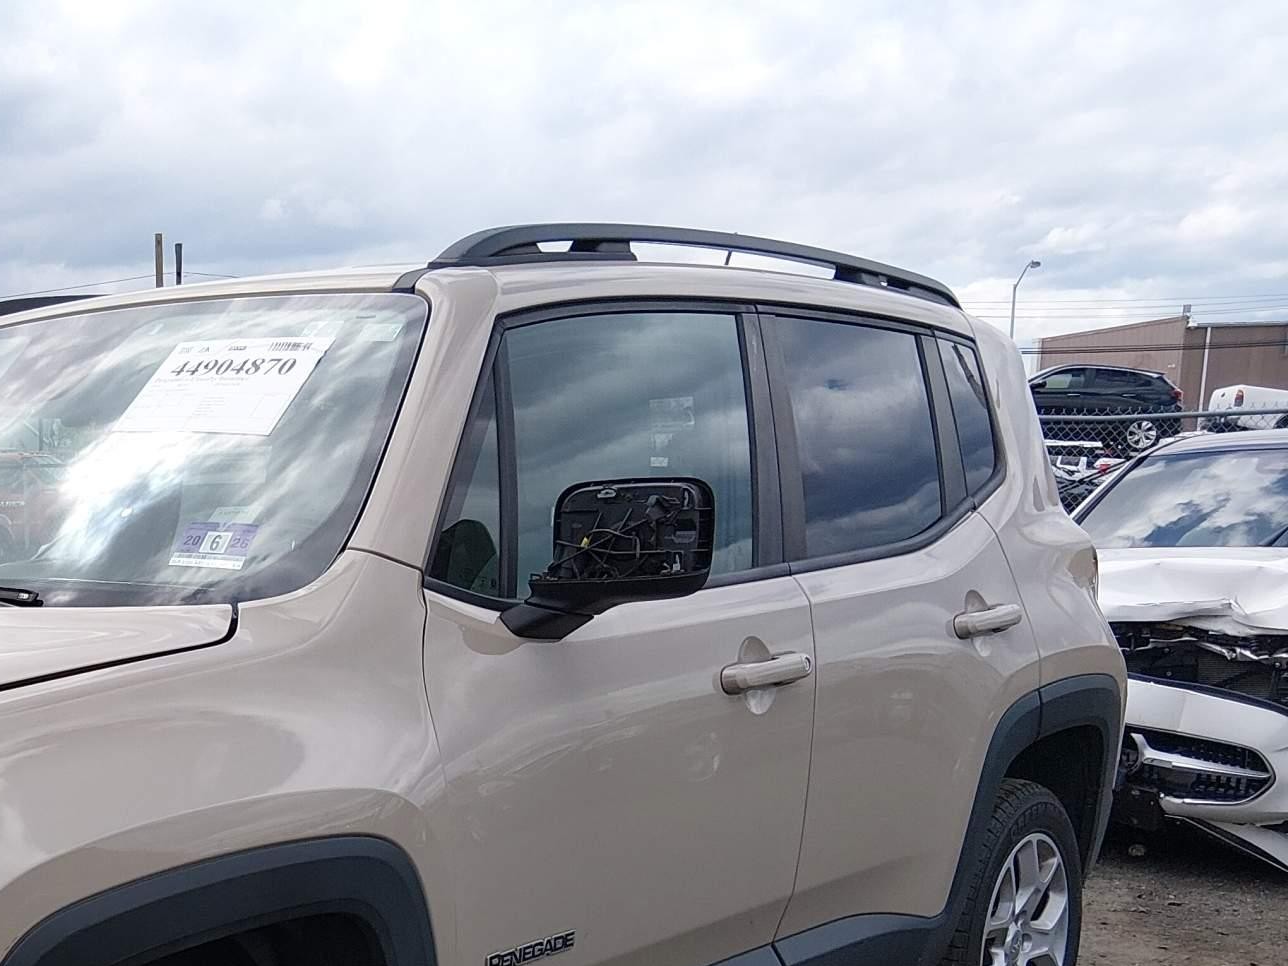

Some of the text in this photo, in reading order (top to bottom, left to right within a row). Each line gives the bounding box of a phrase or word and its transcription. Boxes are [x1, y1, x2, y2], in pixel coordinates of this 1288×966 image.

[170, 357, 297, 377] 44904870
[183, 534, 201, 546] 20
[209, 534, 222, 551] 6
